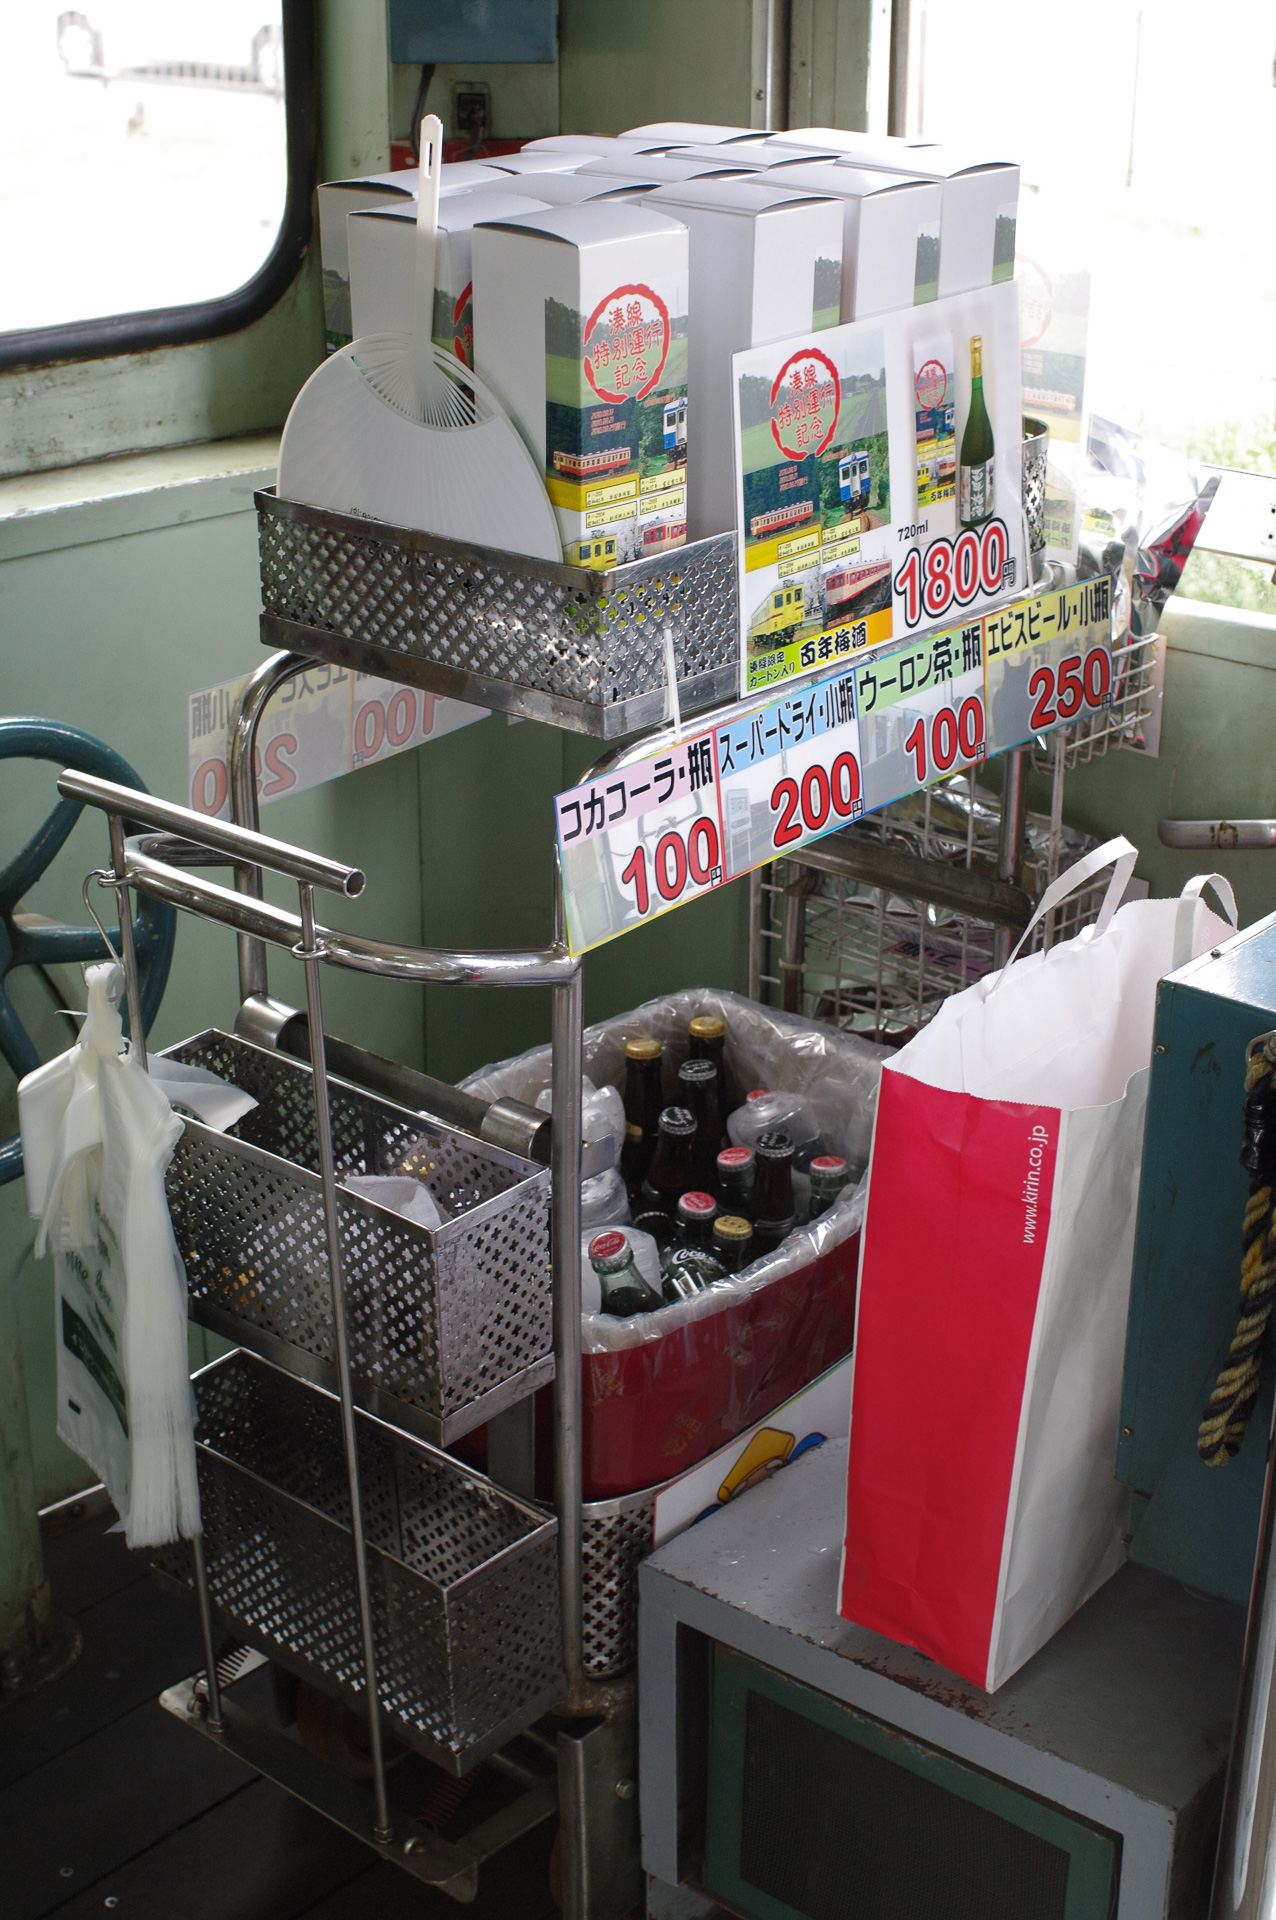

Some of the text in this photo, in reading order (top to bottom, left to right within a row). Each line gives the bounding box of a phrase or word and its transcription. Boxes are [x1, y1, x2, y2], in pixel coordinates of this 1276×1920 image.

[608, 300, 644, 336] 湊線
[592, 322, 663, 370] 特別運行
[614, 357, 649, 391] 記念
[789, 363, 818, 398] 湊線
[777, 382, 835, 429] 特別運行
[795, 418, 824, 449] 記念
[897, 519, 929, 541] 720ml
[987, 577, 1111, 658] エビスビール・小瓶
[749, 651, 786, 674] 湊線限定
[800, 621, 867, 668] 百年梅酒
[858, 623, 982, 713] ウーロン茶・瓶
[749, 662, 796, 688] カートン入り
[719, 675, 854, 776] スーパードライ・小瓶
[560, 742, 714, 842] コカコーラ・瓶
[1021, 1124, 1049, 1244] www.kirin.co.jp
